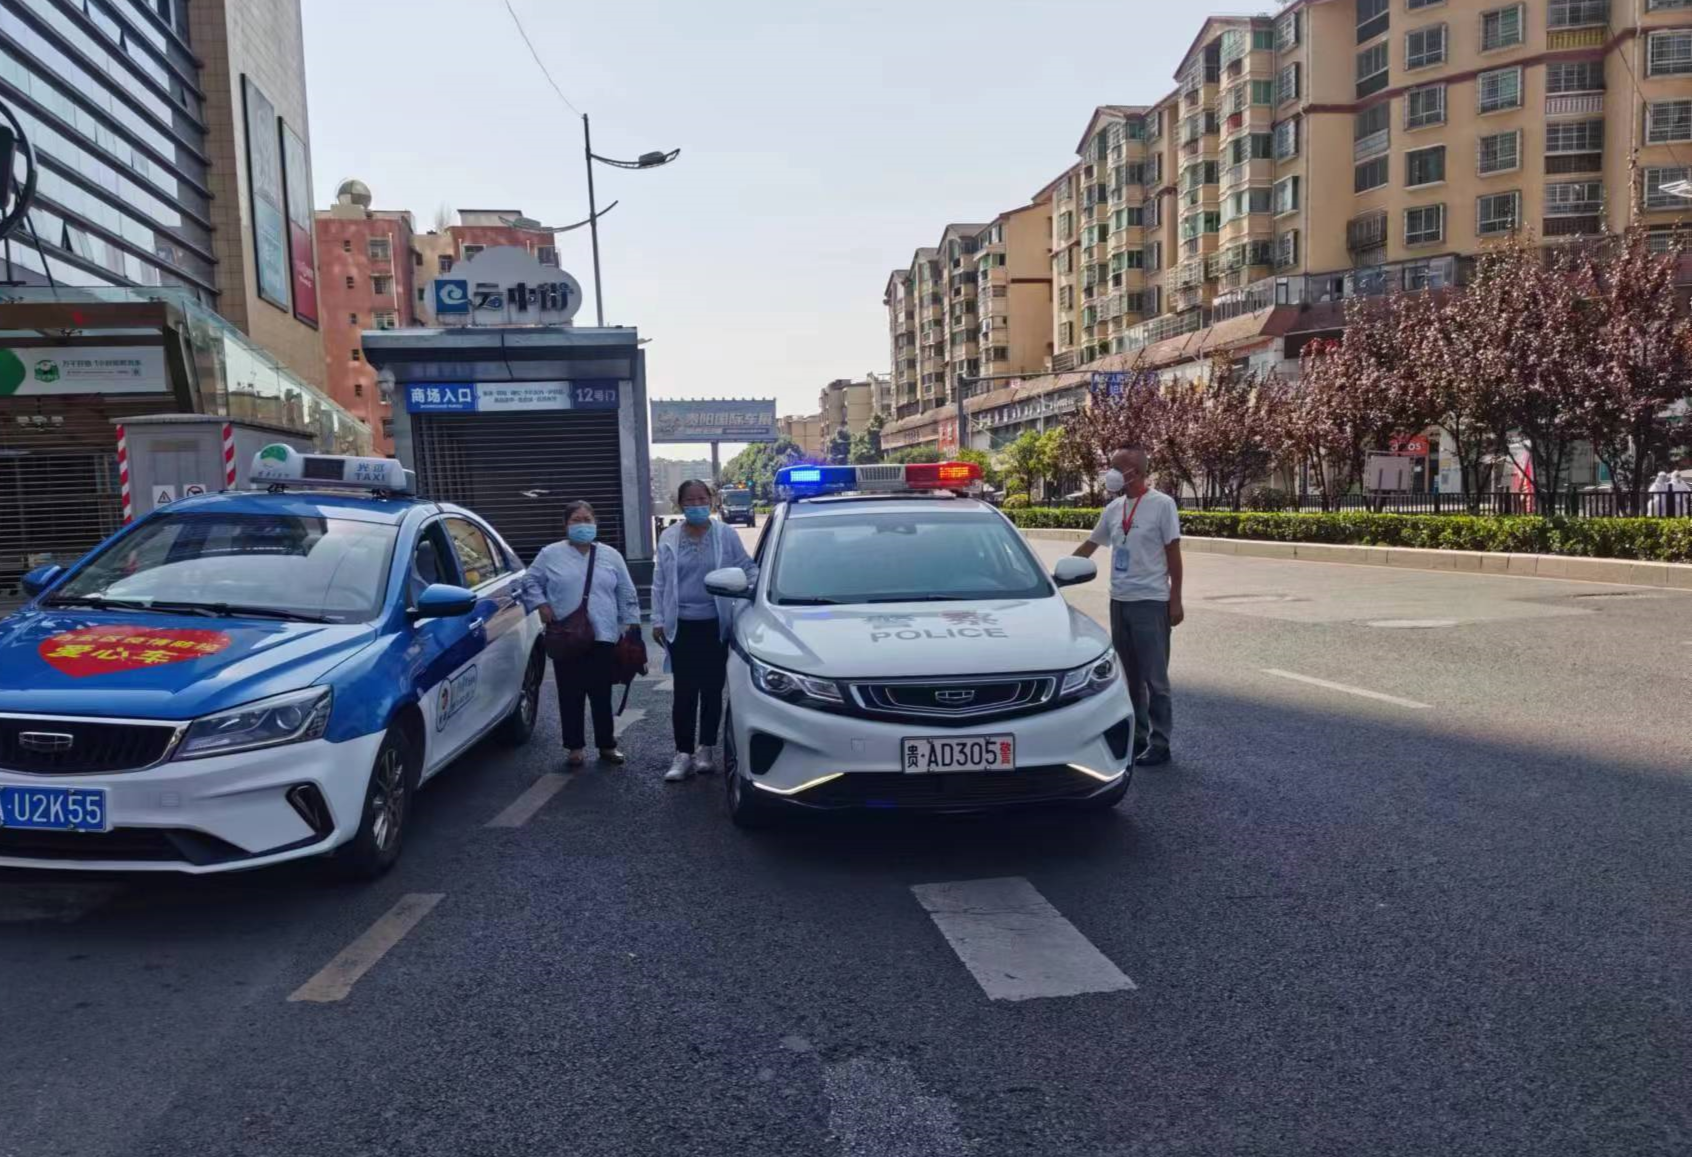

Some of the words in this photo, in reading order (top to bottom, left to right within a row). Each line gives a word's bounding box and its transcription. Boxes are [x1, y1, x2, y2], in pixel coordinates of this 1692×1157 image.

[410, 387, 472, 404] 商场入口
[575, 387, 616, 403] 12号门
[354, 472, 386, 482] TAXI
[870, 628, 1009, 643] POLICE
[46, 644, 179, 664] 爱心车
